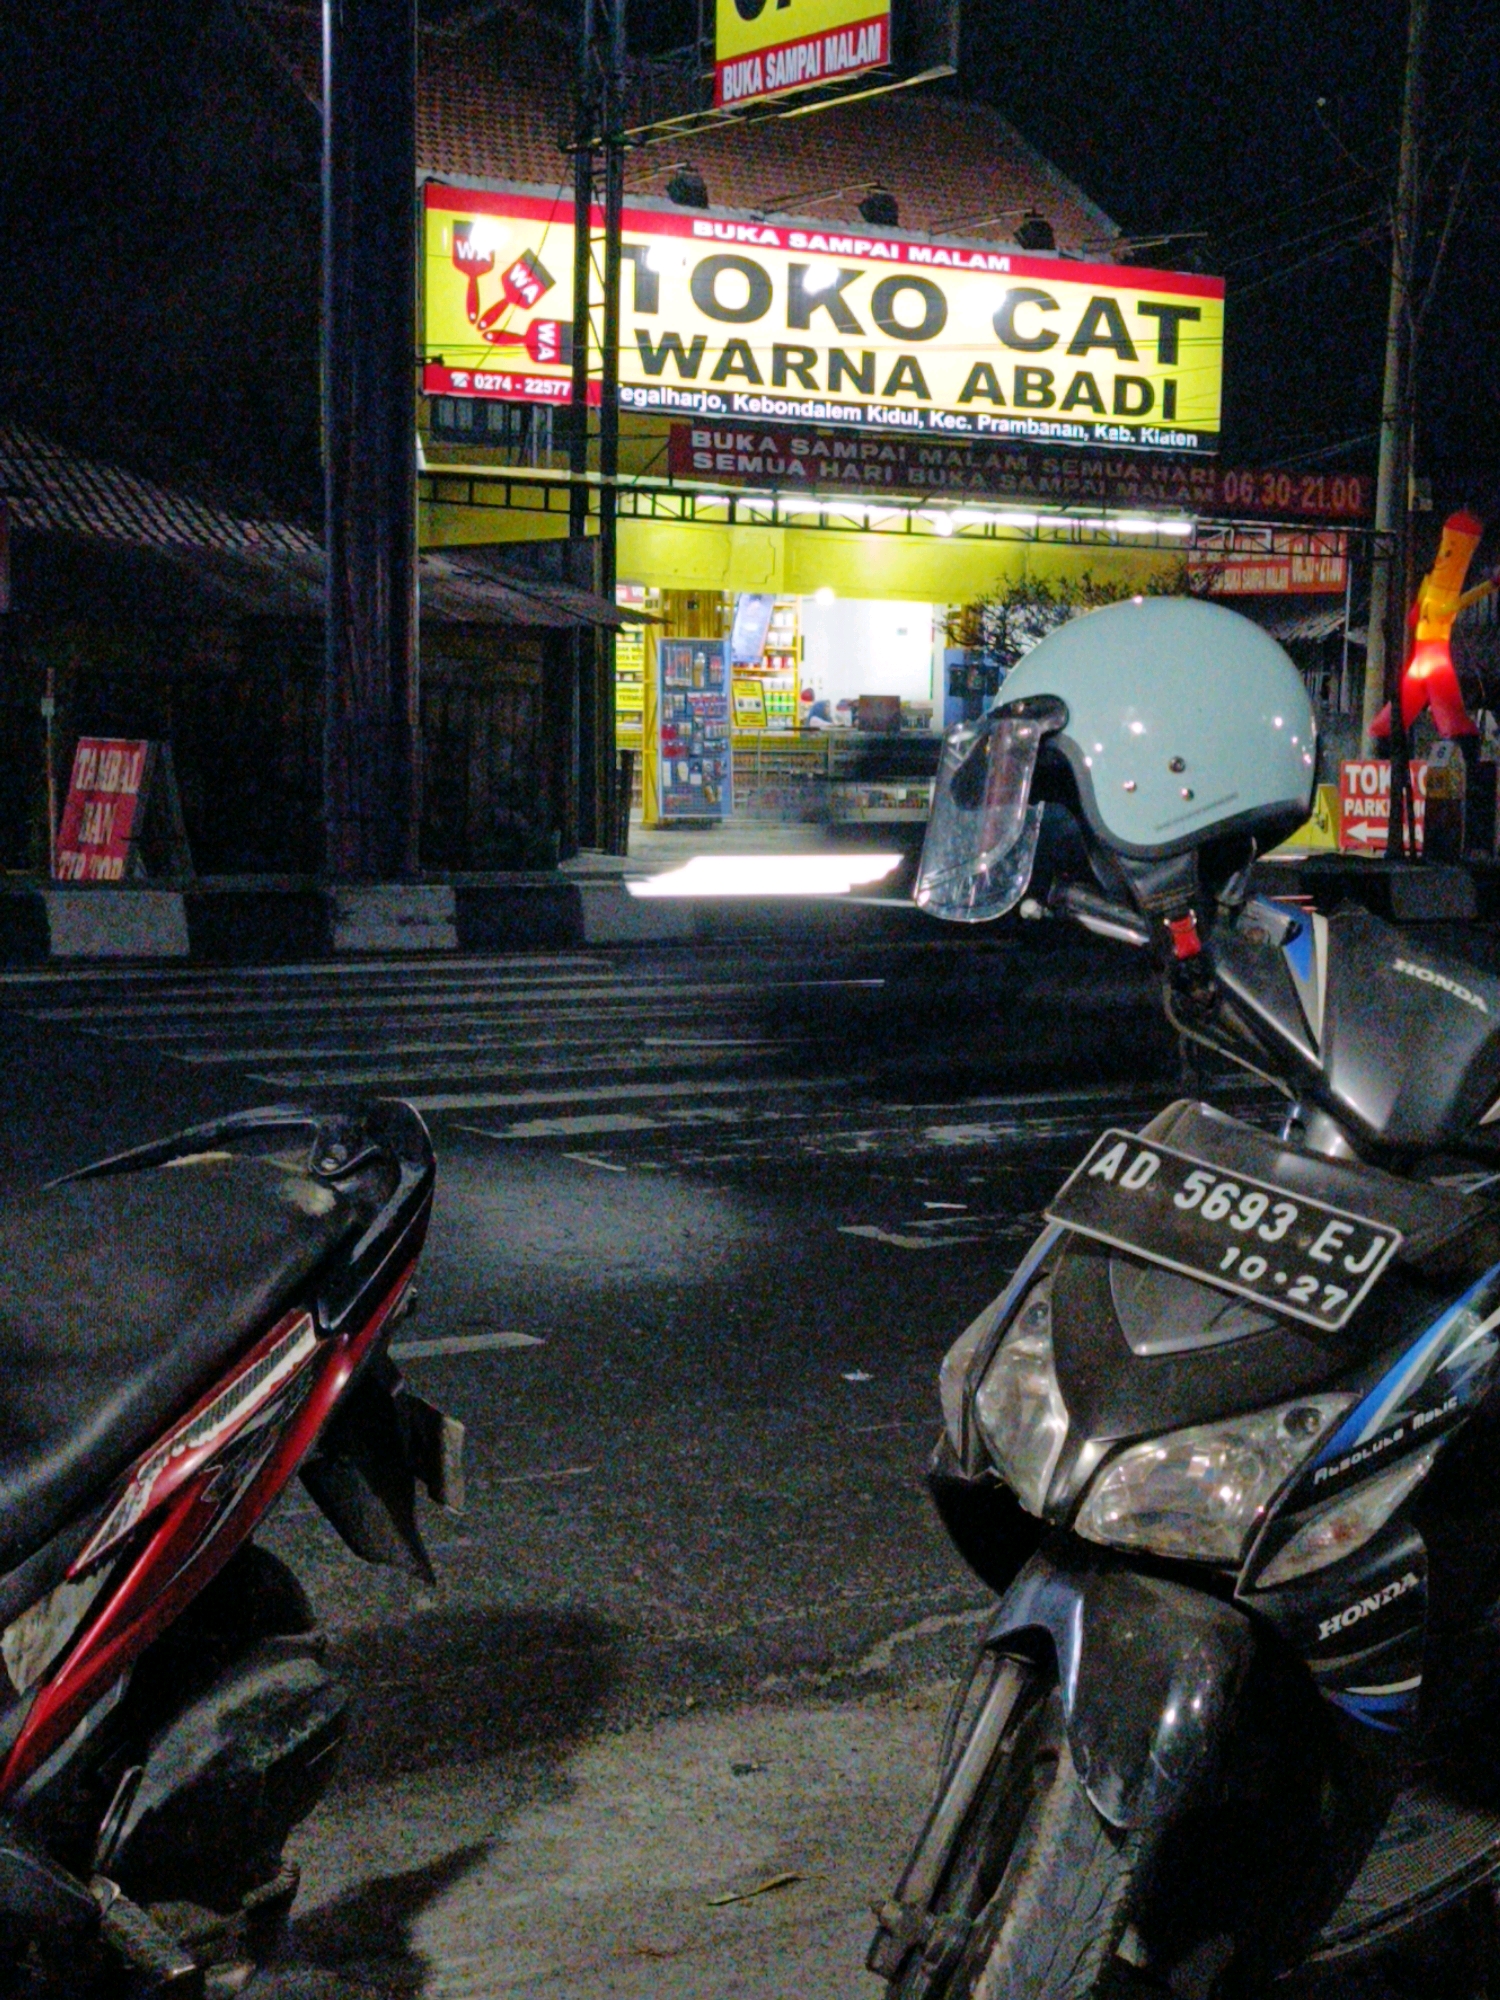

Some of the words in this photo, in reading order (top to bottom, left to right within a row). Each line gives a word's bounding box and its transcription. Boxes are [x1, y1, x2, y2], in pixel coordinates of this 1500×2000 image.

[723, 56, 763, 100] BUKA
[765, 40, 821, 89] SAMPAI
[825, 23, 881, 73] MALAM
[692, 220, 781, 246] BUKA
[789, 231, 899, 259] SAMPAI
[908, 246, 1010, 272] MALAM
[509, 263, 539, 304] WA
[620, 243, 948, 341] TOKO
[992, 286, 1202, 366] CAT
[538, 322, 555, 360] WA
[474, 373, 512, 391] 0274
[634, 328, 932, 400] WARNA
[957, 361, 1178, 420] ABADI
[618, 383, 727, 413] egalharjo,
[733, 393, 862, 421] Kebondalem
[867, 405, 924, 429] Kidul,
[930, 411, 972, 431] Kec.
[977, 414, 1089, 441] Prambanan,
[1095, 423, 1136, 443] Kab.
[1140, 428, 1198, 448] Klaten
[691, 430, 778, 453] BUKA
[790, 438, 905, 462] SAMPAI
[918, 448, 1028, 472] MALAM
[1041, 457, 1142, 479] SEMUA
[693, 452, 806, 476] SEMUA
[819, 461, 892, 482] HARI
[907, 468, 986, 489] BUKA
[999, 473, 1105, 495] SAMPAI
[1089, 1142, 1160, 1190] AD
[1174, 1170, 1298, 1242] 5693
[1309, 1219, 1386, 1274] EJ
[1318, 1572, 1420, 1641] HONDA
